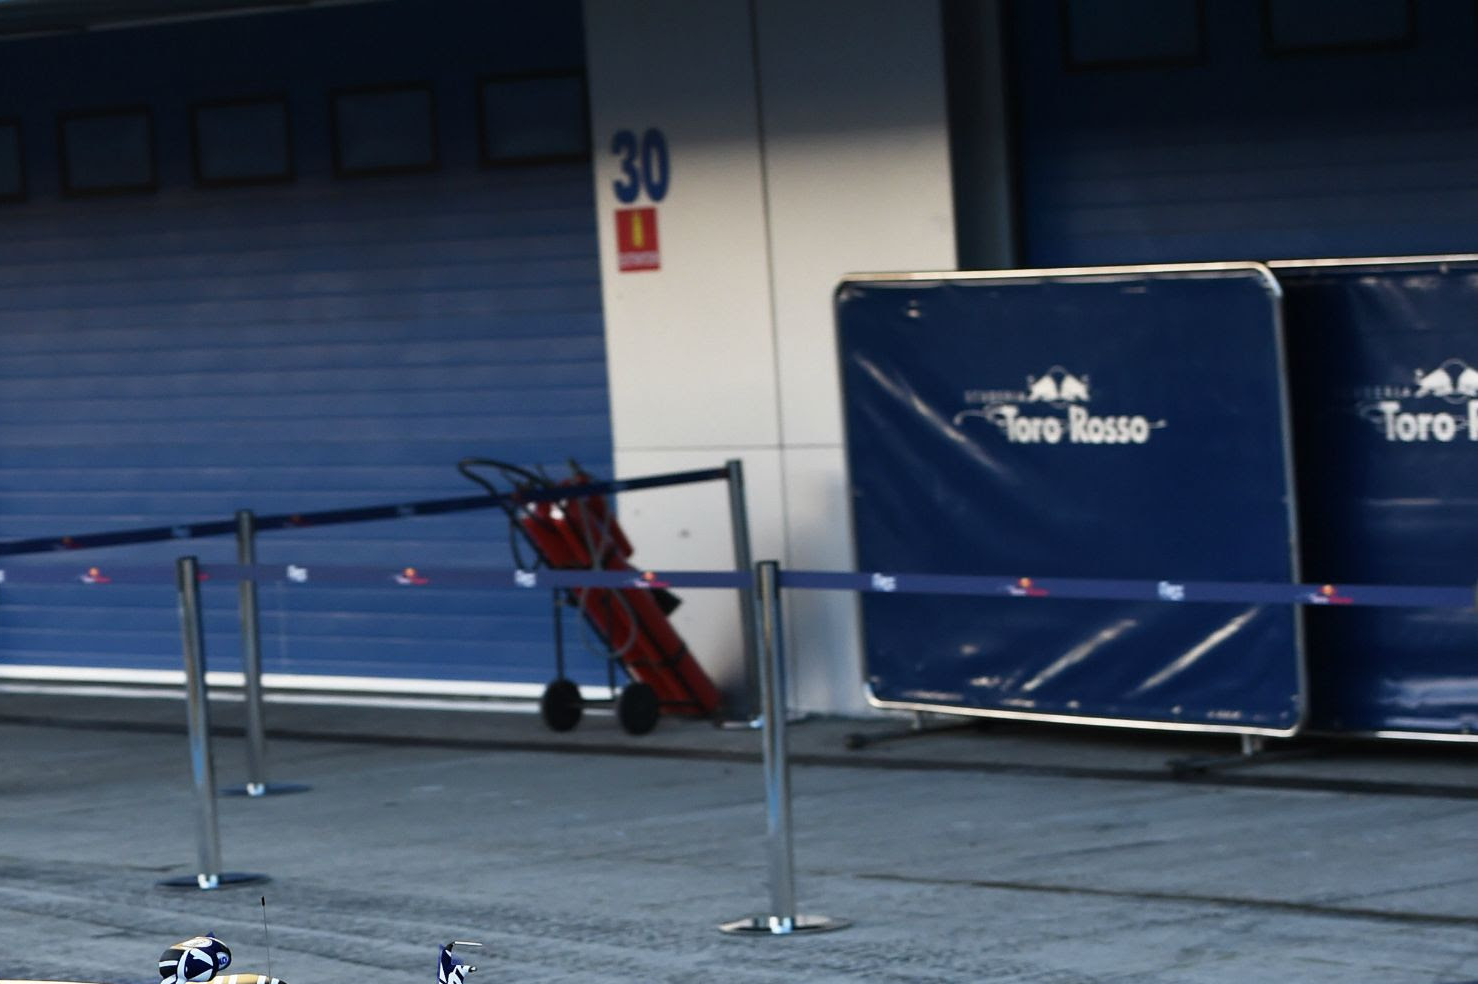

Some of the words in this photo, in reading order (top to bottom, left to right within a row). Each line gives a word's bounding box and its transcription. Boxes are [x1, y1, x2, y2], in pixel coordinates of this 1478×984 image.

[611, 128, 669, 203] 30
[999, 404, 1063, 443] Toro
[1068, 404, 1150, 443] Rosso
[1380, 401, 1456, 441] Toro
